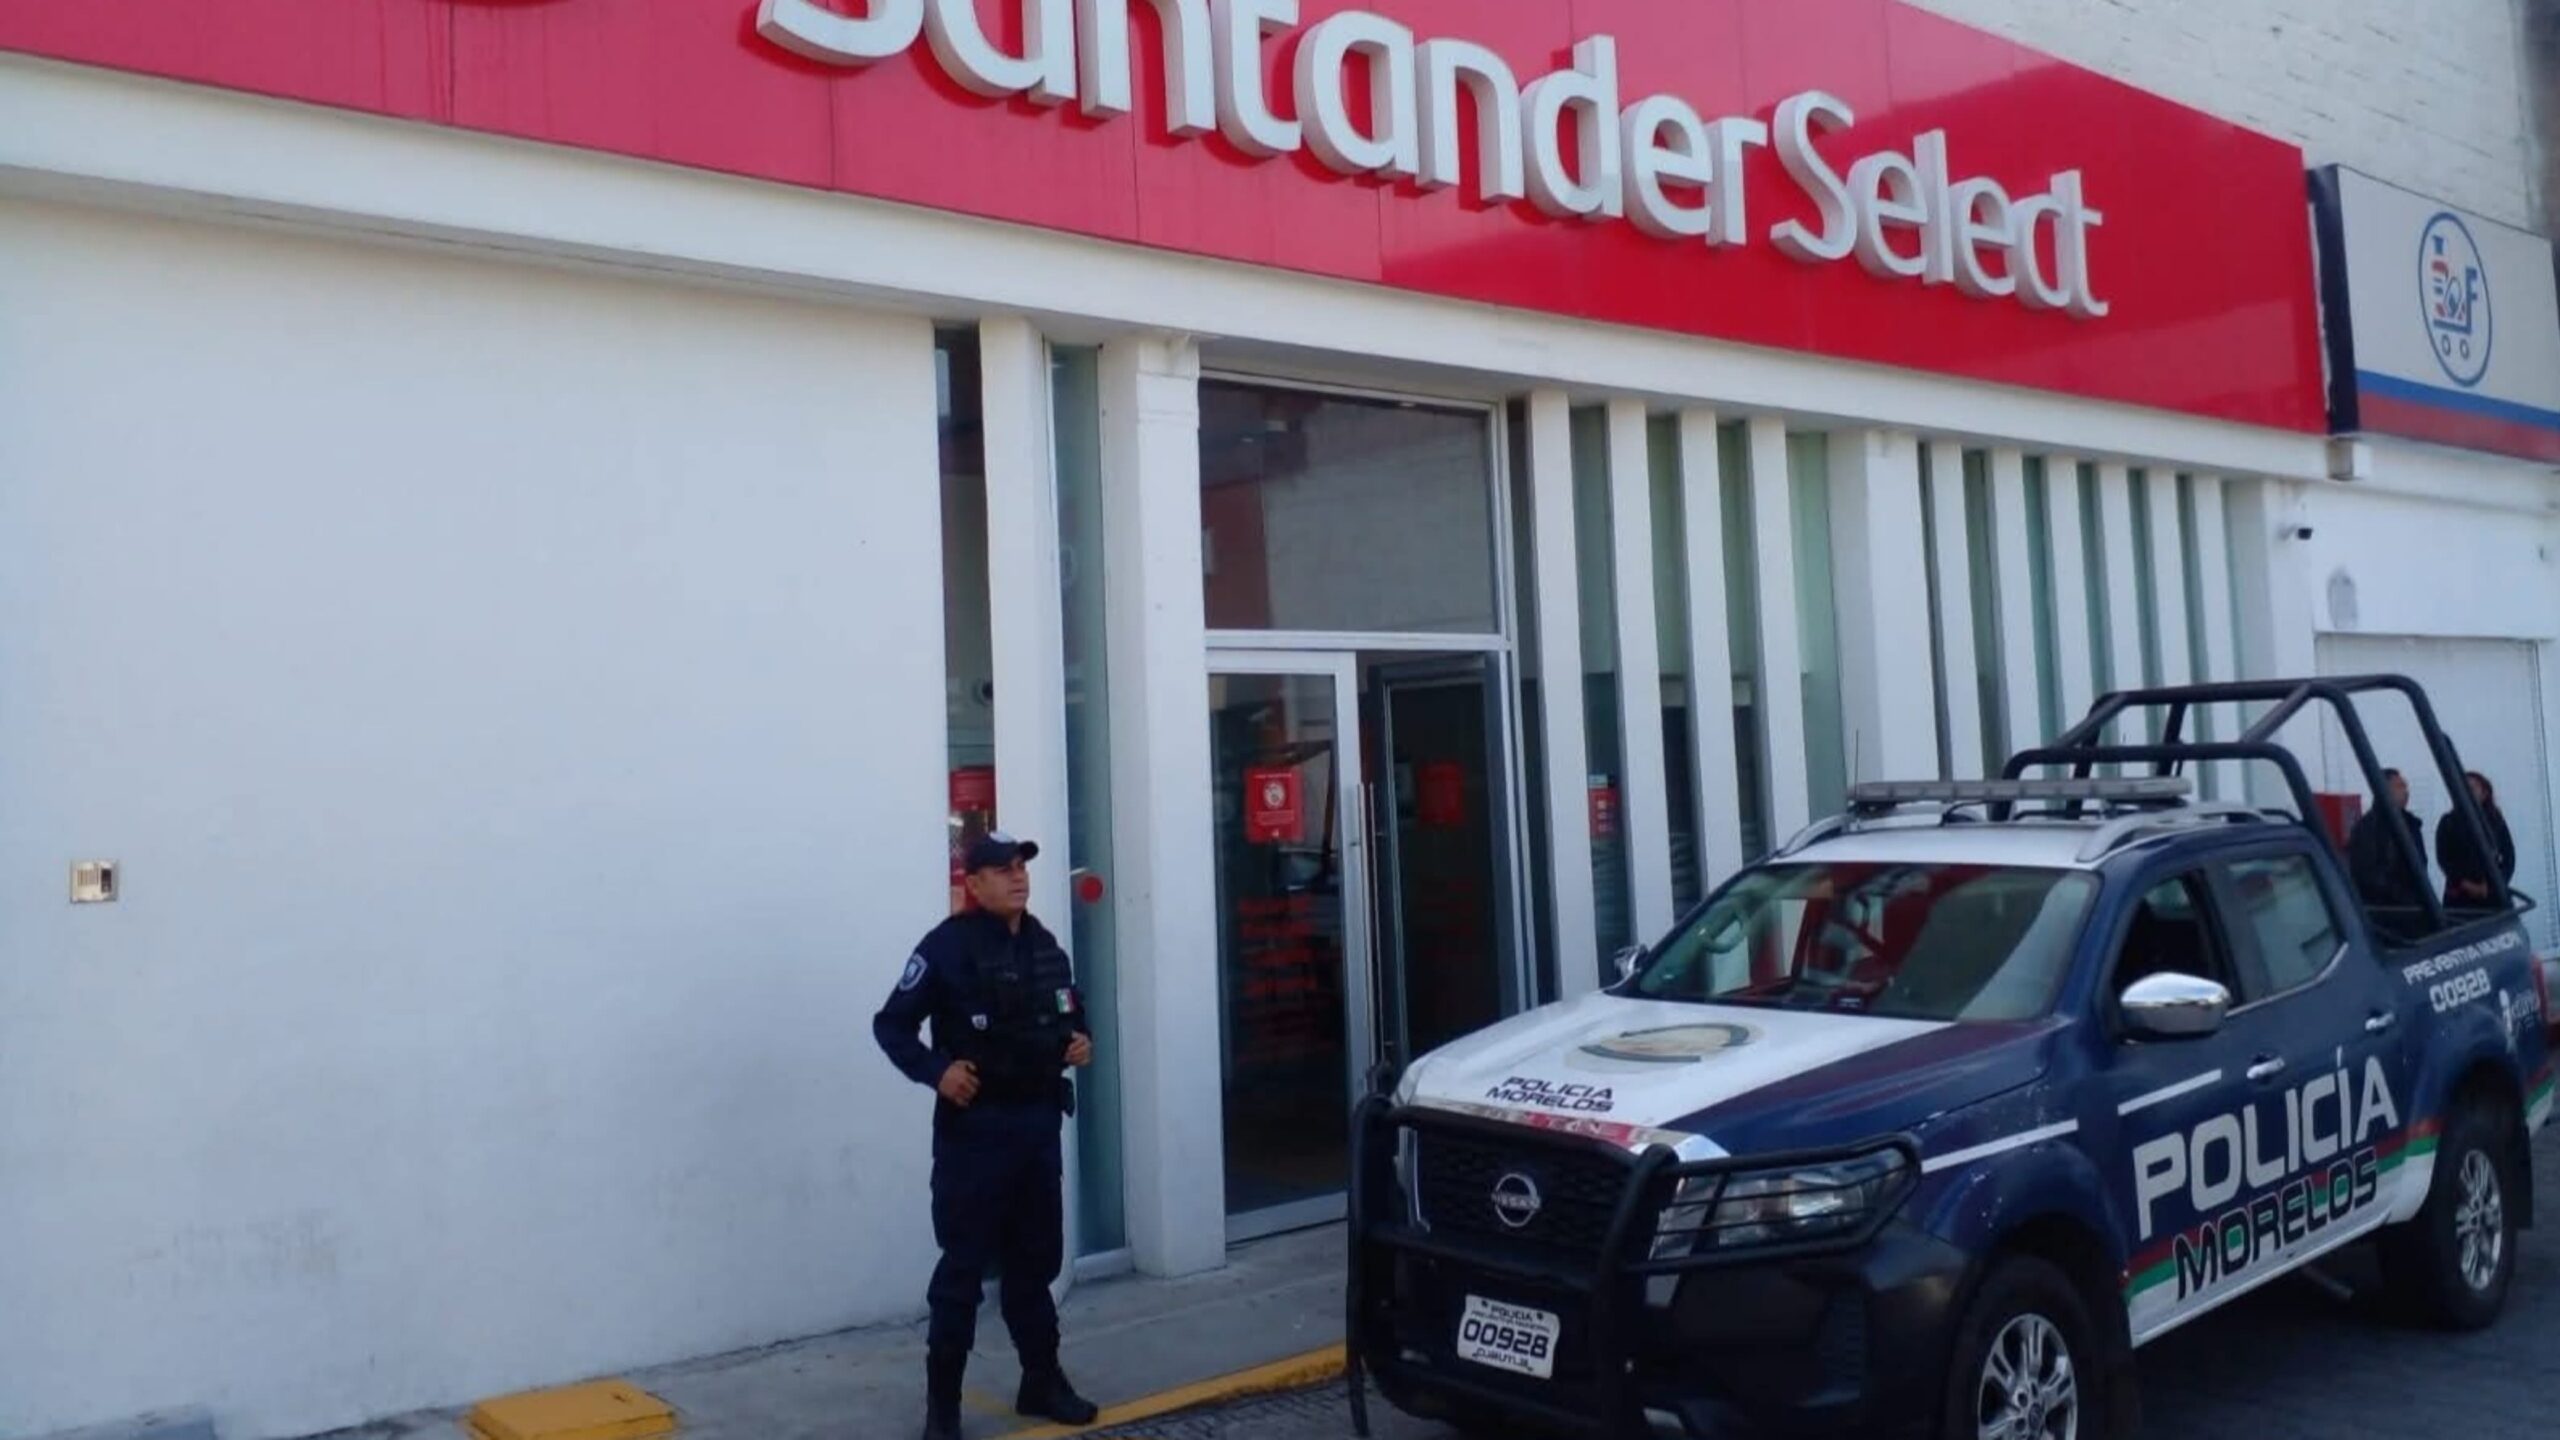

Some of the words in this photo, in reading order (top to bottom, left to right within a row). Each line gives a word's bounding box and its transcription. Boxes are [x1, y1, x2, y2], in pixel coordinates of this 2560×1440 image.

[1770, 90, 2108, 317] Select
[2429, 967, 2491, 1013] 00928
[1485, 1086, 1615, 1112] MORELOS
[1502, 1076, 1613, 1100] POLICIA
[2132, 1045, 2399, 1241] POLICÍA
[2171, 1145, 2378, 1301] MORELOS
[1463, 1317, 1549, 1360] 00928
